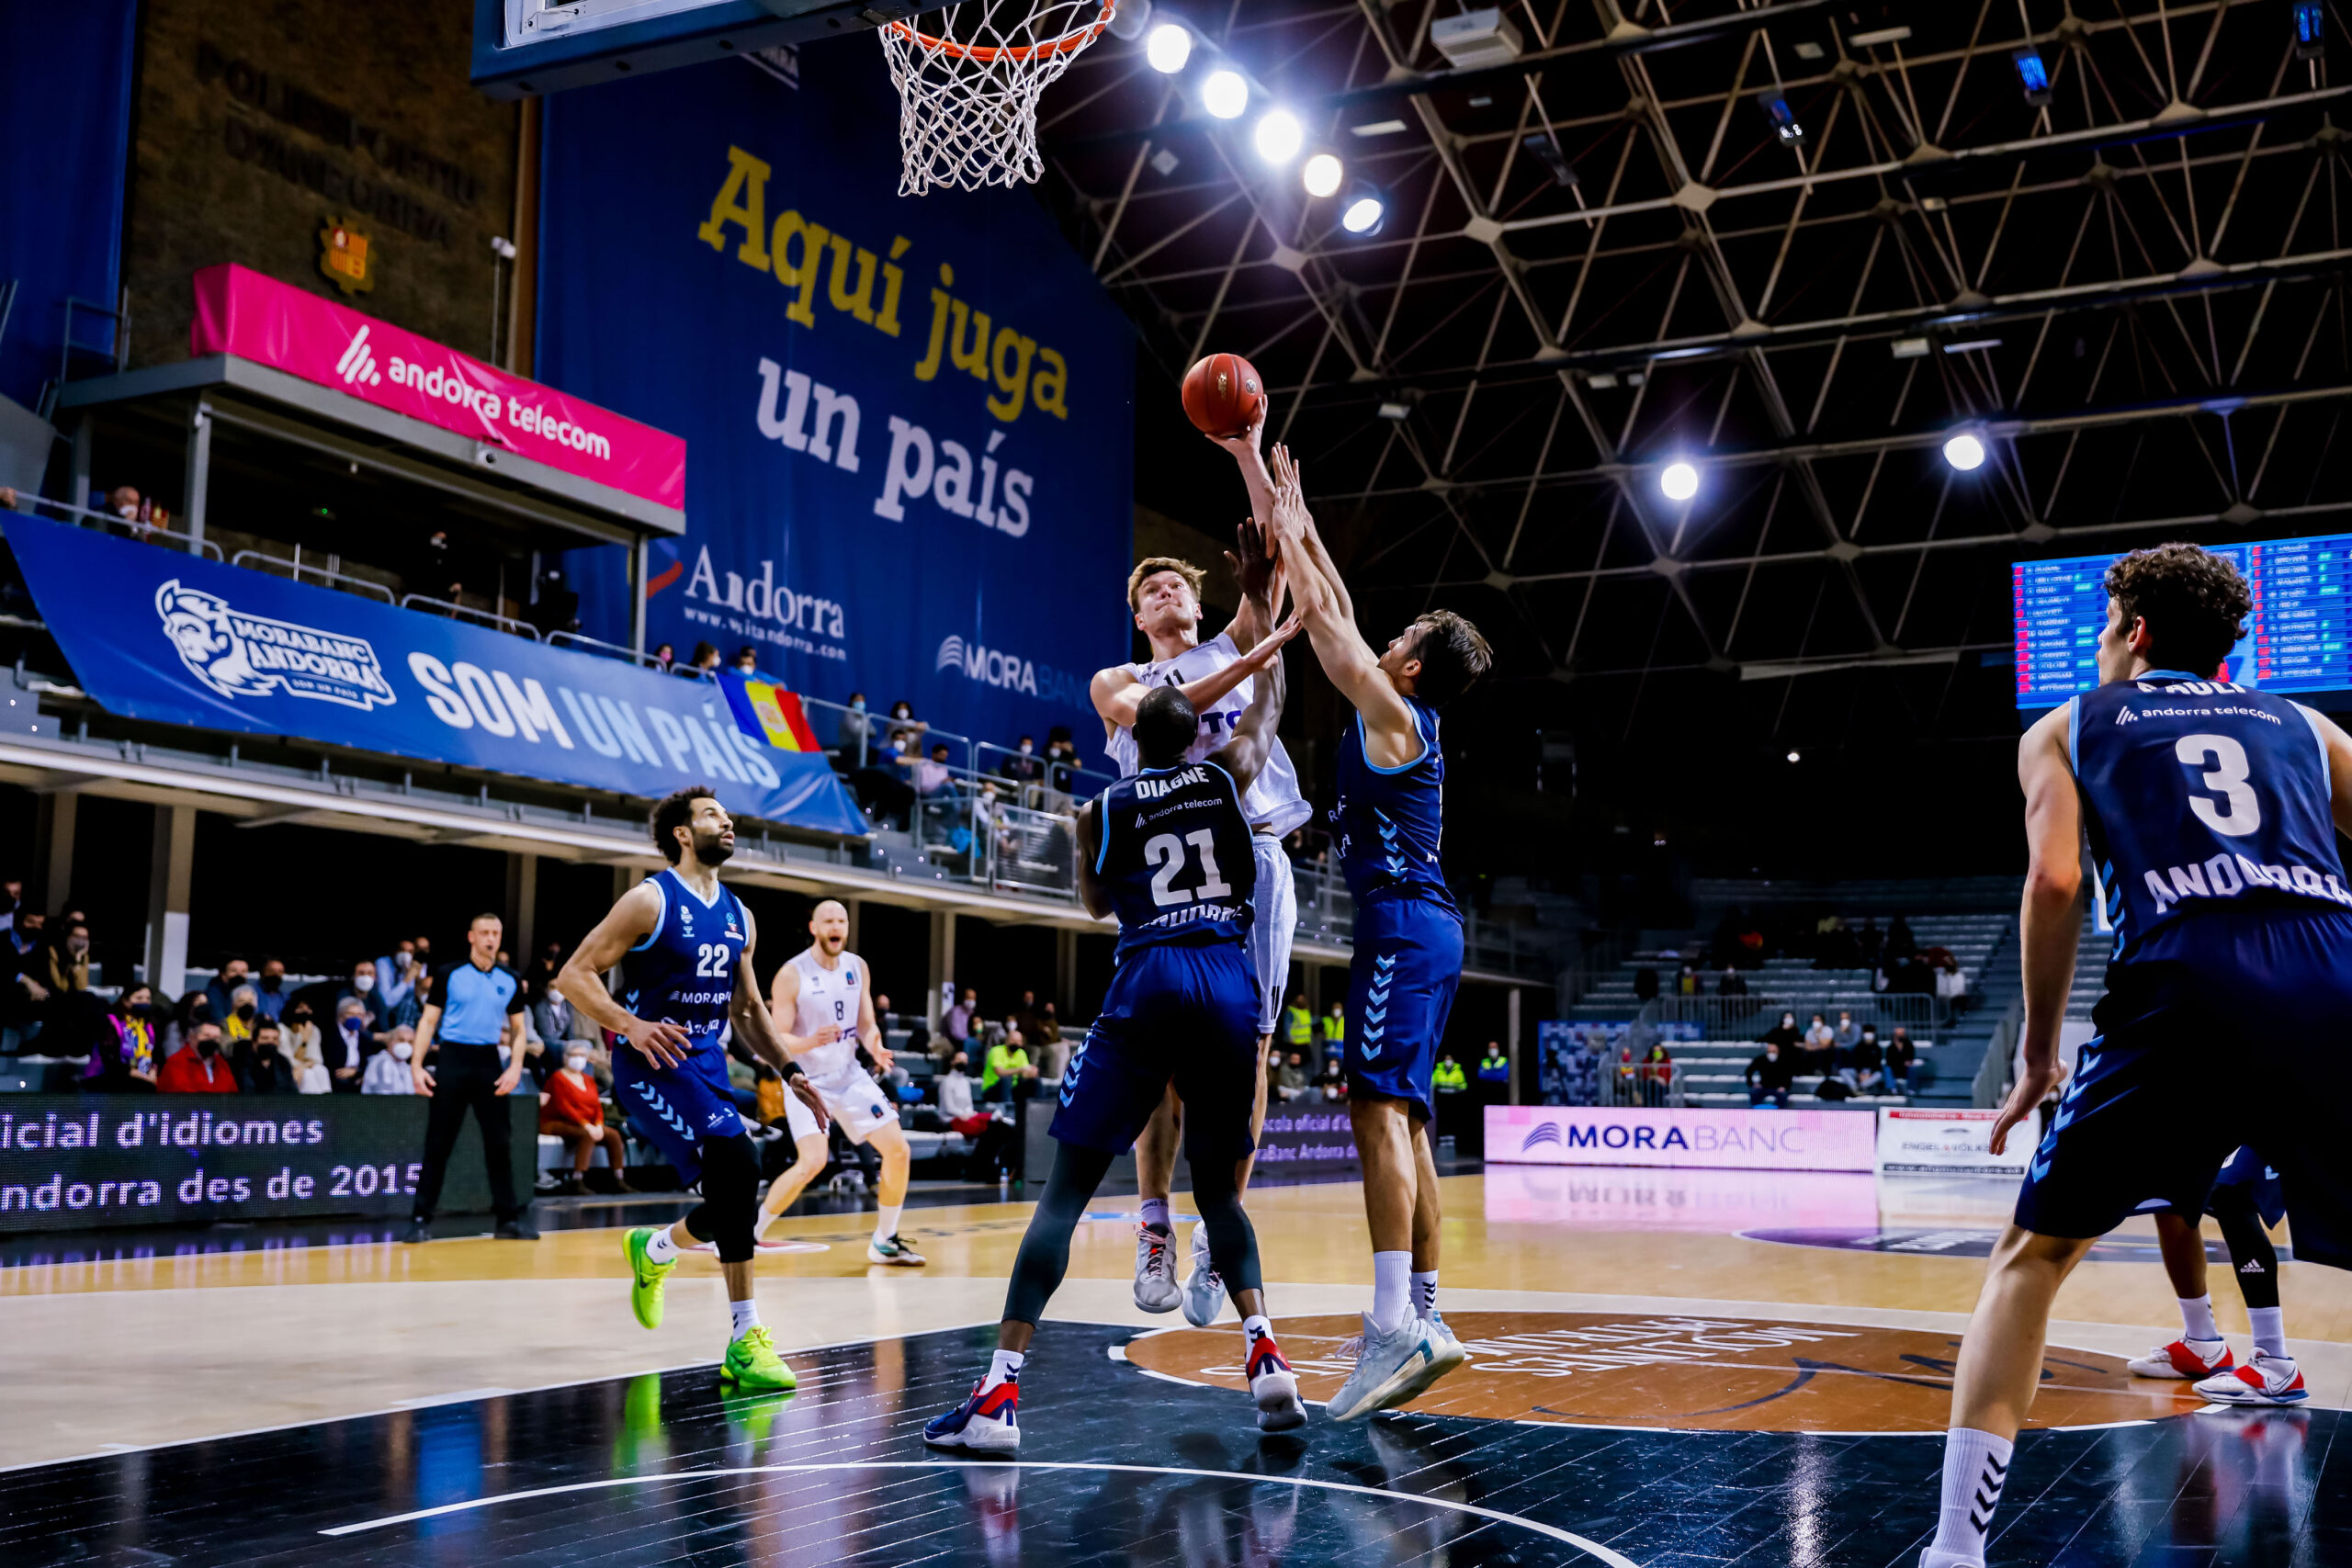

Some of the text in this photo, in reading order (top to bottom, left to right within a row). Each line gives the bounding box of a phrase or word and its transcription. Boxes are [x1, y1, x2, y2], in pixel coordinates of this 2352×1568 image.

[698, 145, 1069, 423] Aquí juga
[389, 356, 610, 461] andorra telecom
[757, 356, 1034, 537] un país
[684, 544, 845, 638] Andorra
[232, 617, 370, 663] MORABANC
[247, 640, 387, 694] ANDORRA
[407, 651, 781, 790] SOM UN PAÍS
[2142, 705, 2281, 726] andorra telecom
[1135, 767, 1210, 800] DIAGNE
[2175, 734, 2261, 837] 3
[1148, 797, 1223, 821] andorra telecom
[1144, 828, 1232, 907] 21
[695, 943, 730, 977] 22
[834, 1000, 844, 1021] 8
[117, 1111, 324, 1148] d'idiomes
[1567, 1123, 1806, 1154] MORABANC
[177, 1168, 251, 1204] des
[266, 1167, 316, 1200] de
